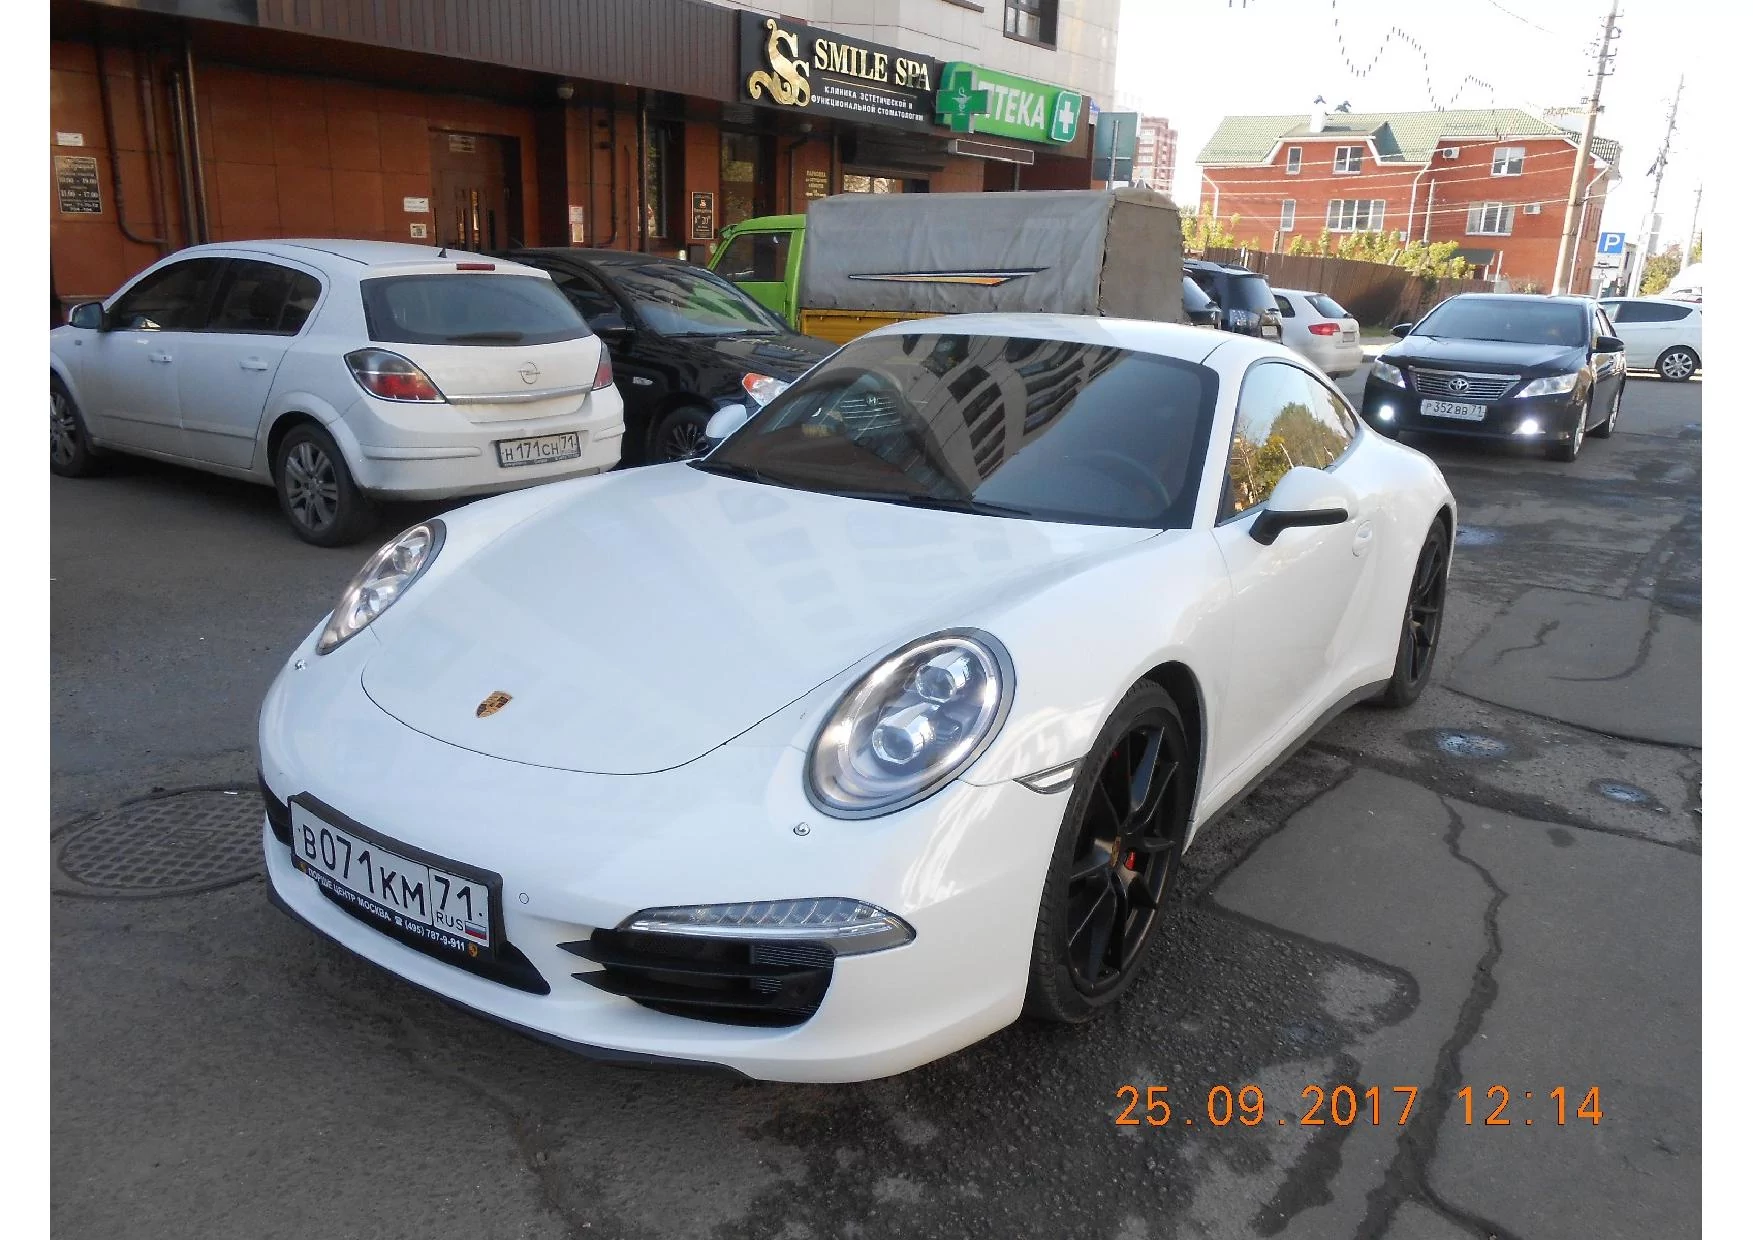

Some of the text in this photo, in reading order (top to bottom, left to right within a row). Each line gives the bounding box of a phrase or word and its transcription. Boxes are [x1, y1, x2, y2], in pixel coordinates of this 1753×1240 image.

[814, 38, 931, 91] SMILE SPA
[811, 94, 876, 113] ФУНКЦИОНАЛЬНОЙ
[824, 85, 857, 99] КЛИНИКА
[859, 92, 907, 108] ЭСТЕТИЧЕСКОЙ
[1603, 233, 1621, 252] P
[434, 875, 472, 921] 71
[333, 883, 356, 902] ЦЕНТР
[404, 920, 425, 937] (495)
[436, 912, 464, 931] RUS
